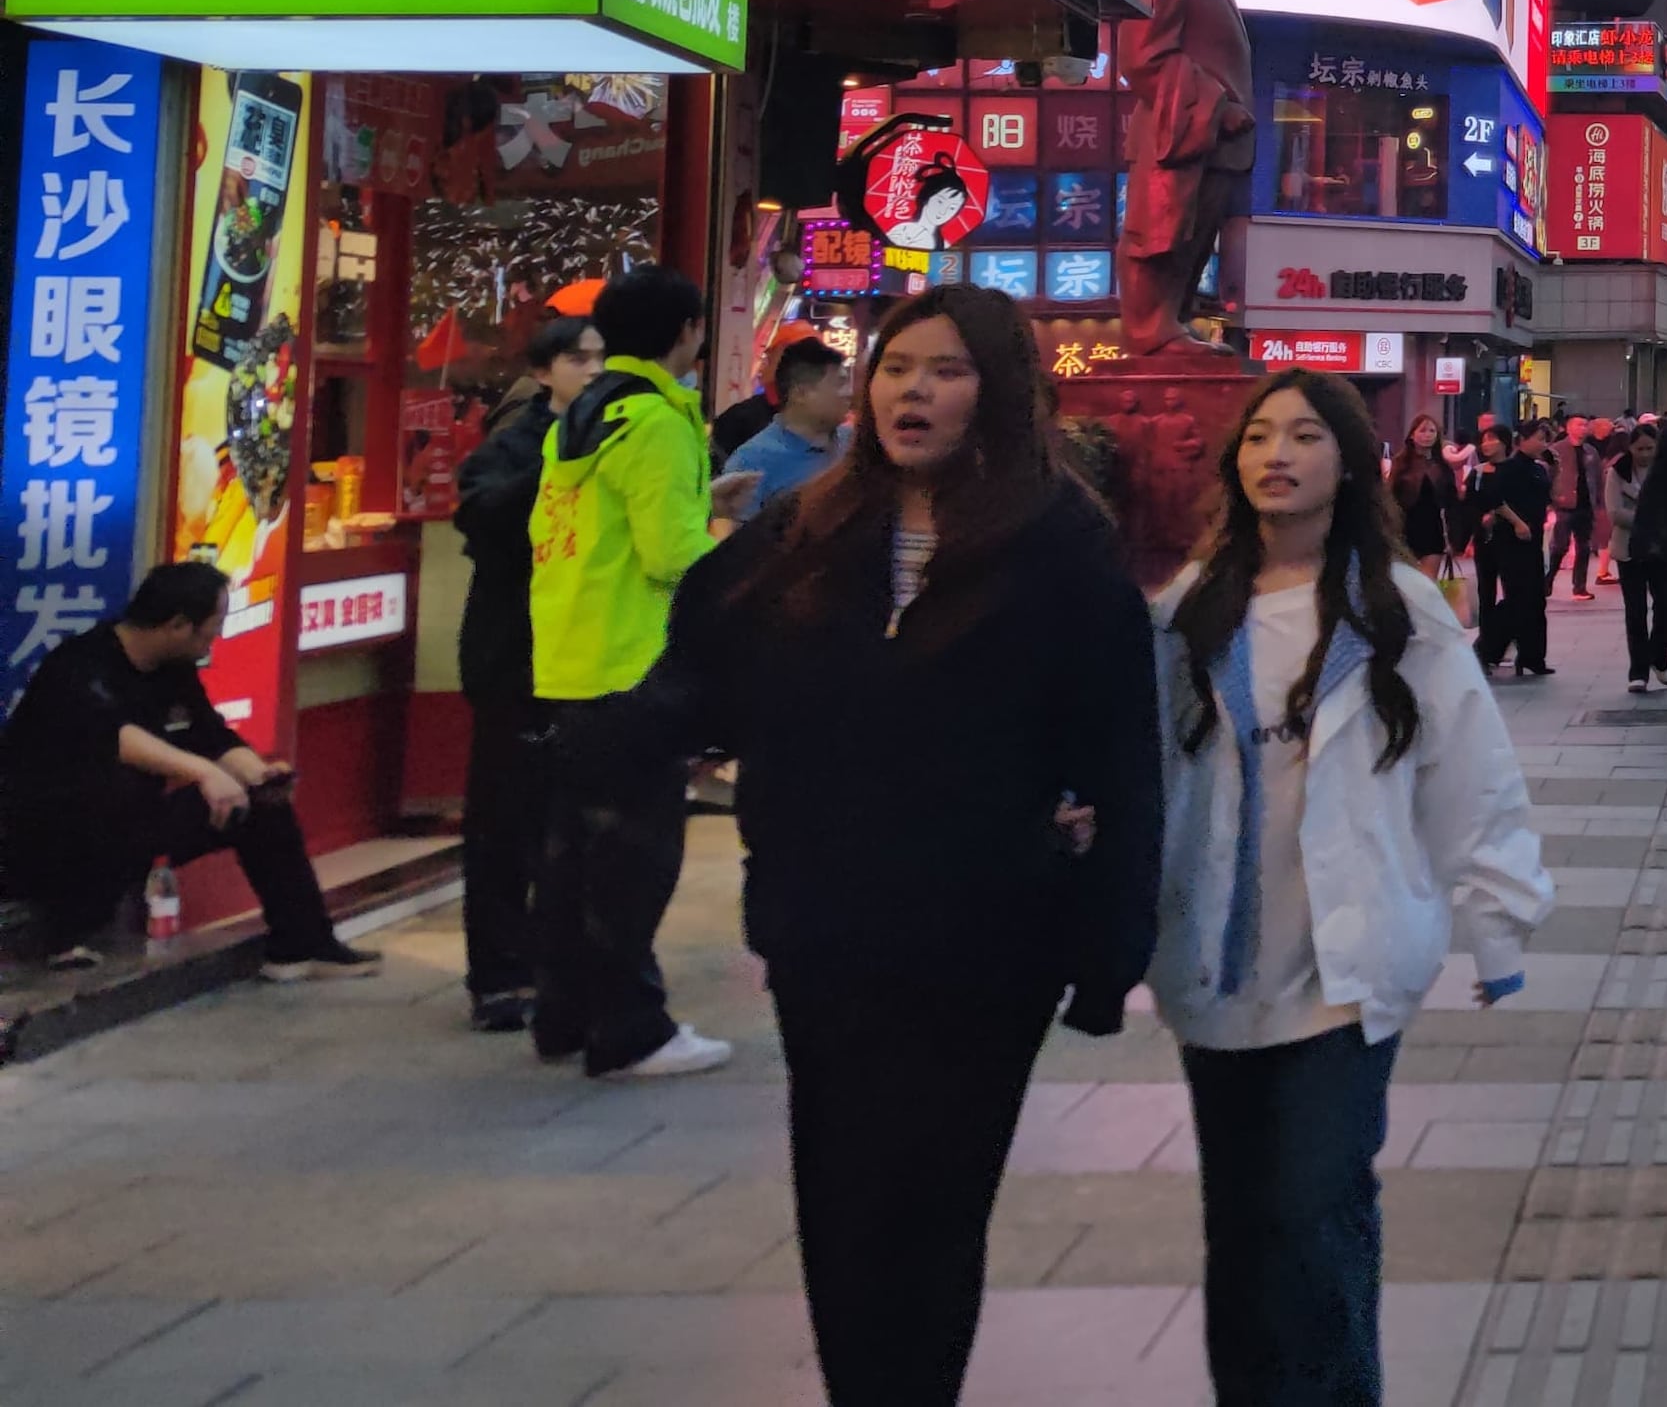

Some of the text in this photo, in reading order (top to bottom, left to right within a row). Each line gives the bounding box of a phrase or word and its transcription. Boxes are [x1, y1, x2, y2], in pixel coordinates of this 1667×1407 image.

[1464, 116, 1494, 143] 2F
[1587, 148, 1606, 232] 海底捞火锅
[812, 231, 872, 266] 配镜
[1277, 266, 1468, 302] 24h 自助银行服务
[1262, 339, 1347, 361] 24h 自助银行服务
